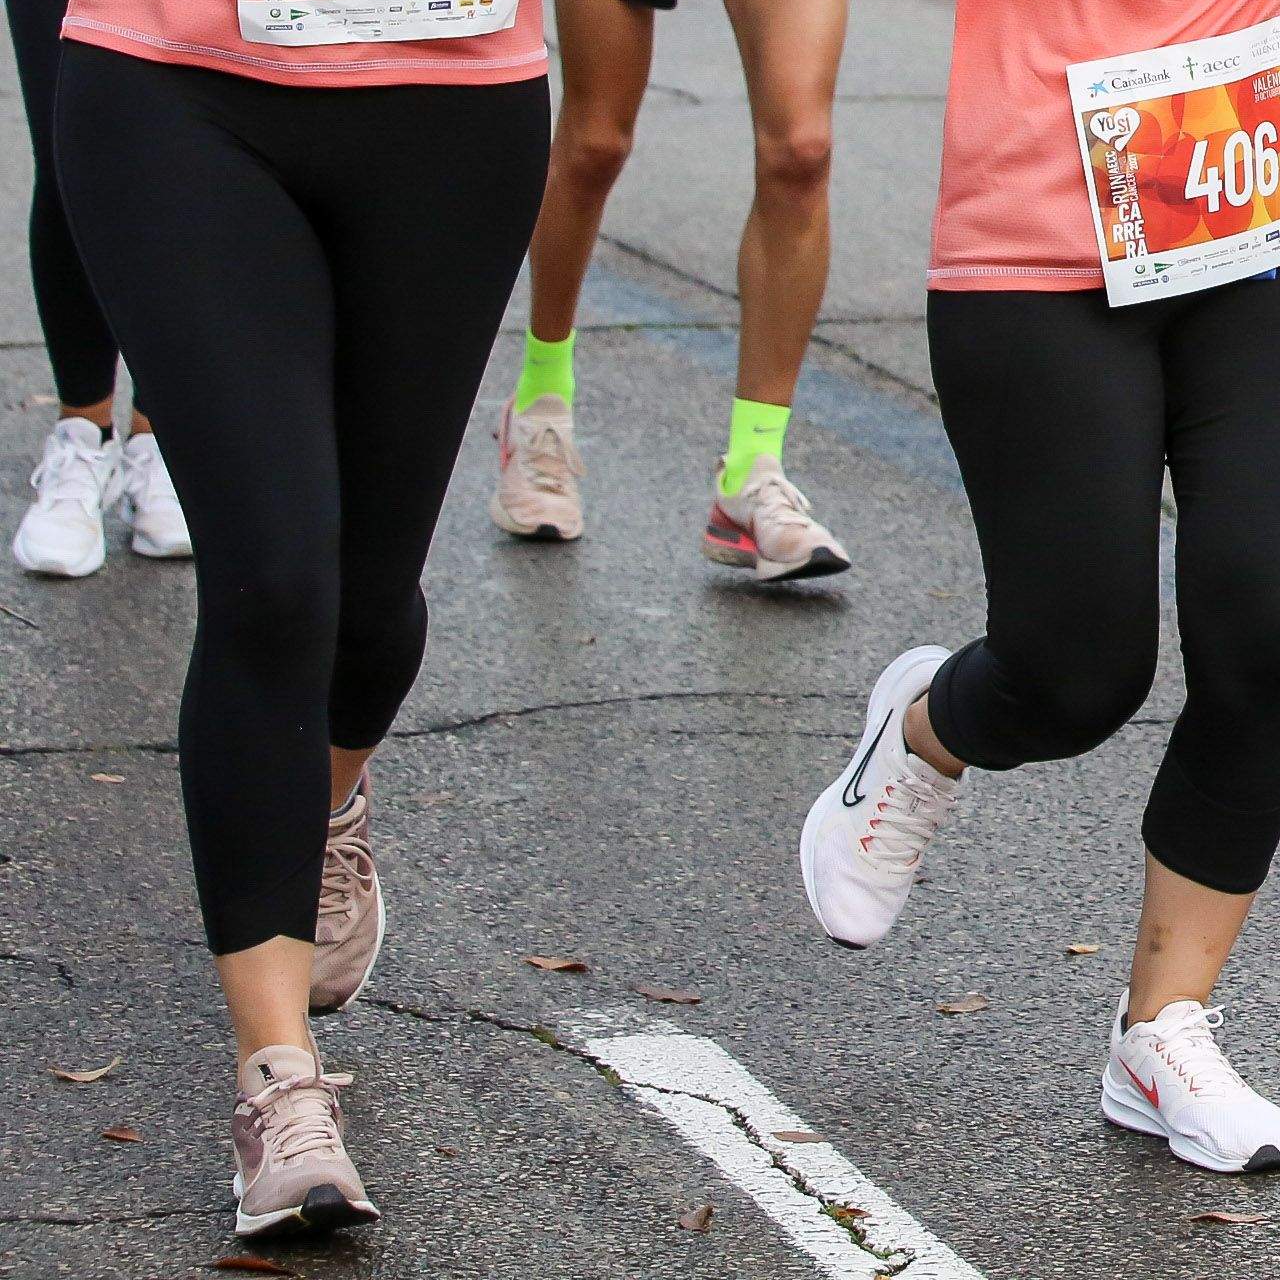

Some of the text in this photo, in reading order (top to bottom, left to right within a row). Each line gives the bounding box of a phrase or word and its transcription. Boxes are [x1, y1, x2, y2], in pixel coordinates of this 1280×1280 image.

[1202, 55, 1241, 73] aecc
[1110, 69, 1171, 90] CaixaBank
[1098, 117, 1115, 132] YO
[1184, 120, 1280, 214] 406
[1104, 150, 1127, 205] RUN AECC
[1118, 203, 1141, 223] CA
[1112, 220, 1145, 243] RRE
[1126, 240, 1148, 259] RA
